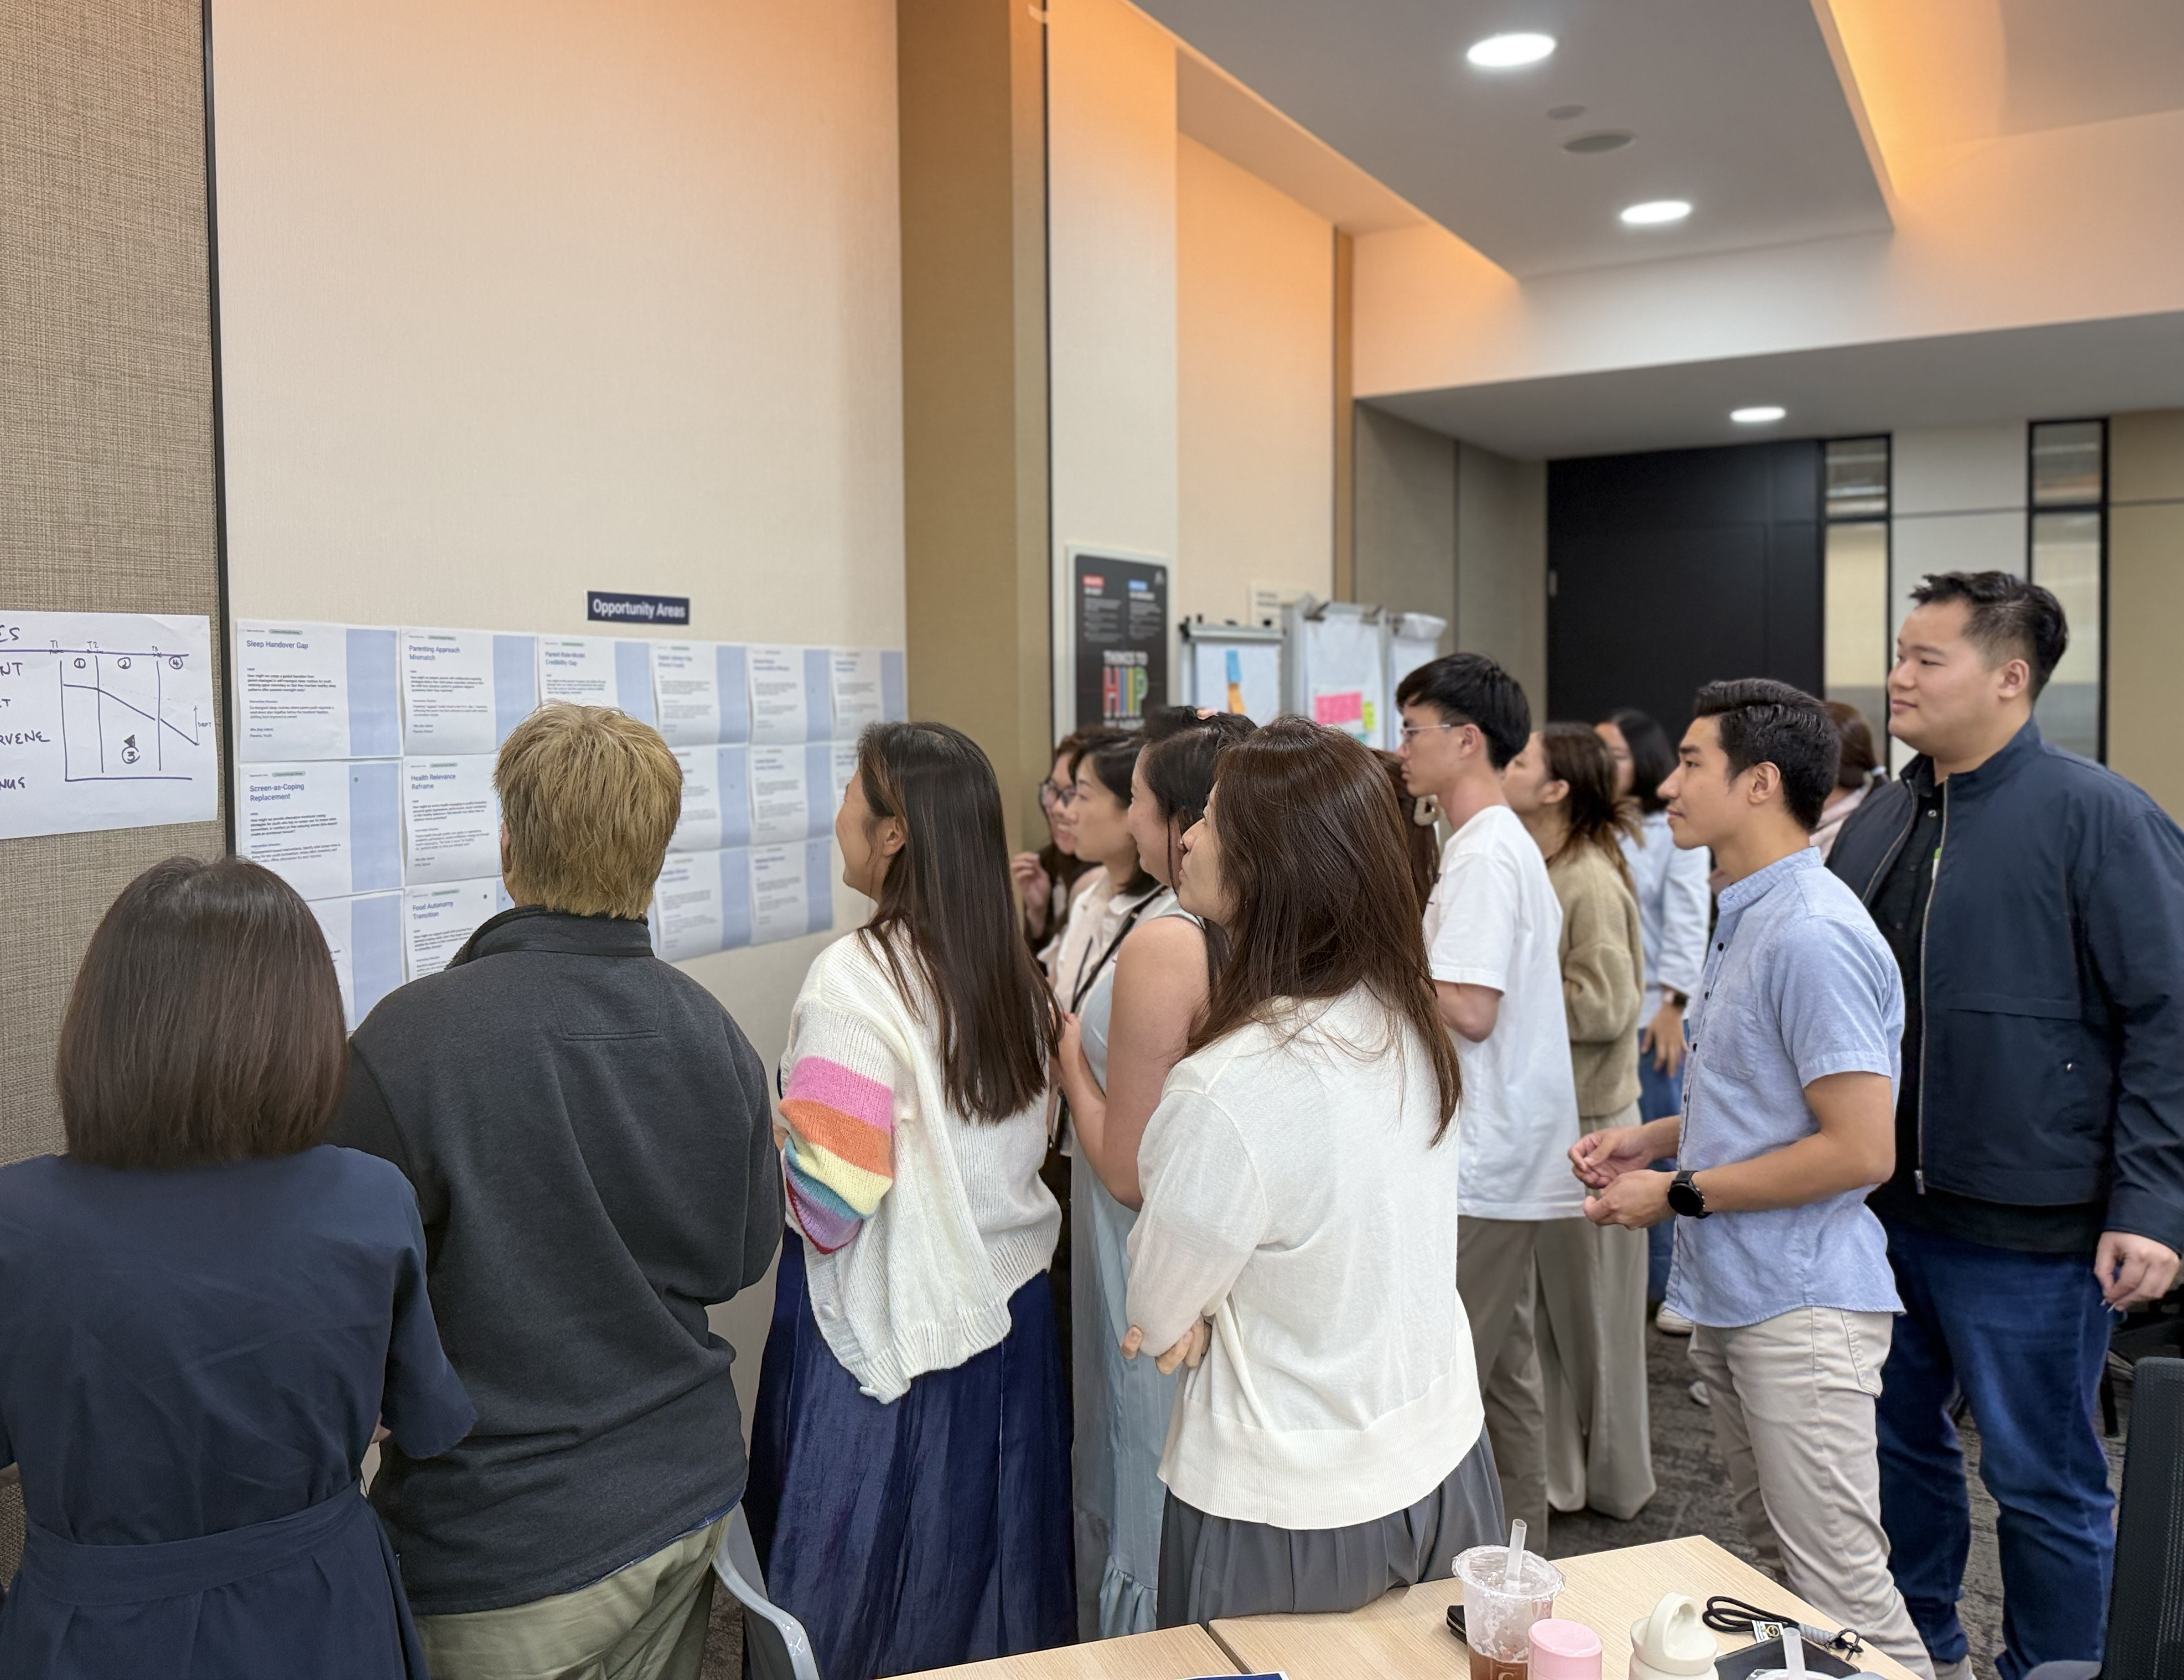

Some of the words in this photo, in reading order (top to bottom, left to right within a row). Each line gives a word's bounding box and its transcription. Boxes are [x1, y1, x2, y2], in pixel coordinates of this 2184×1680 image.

[593, 599, 654, 620] Opportunity
[656, 603, 685, 618] Areas
[50, 640, 58, 648] T1
[409, 645, 434, 654] Parenting
[250, 783, 305, 792] Screen-as-Coping
[250, 793, 291, 802] Replacement
[412, 911, 439, 920] Transition
